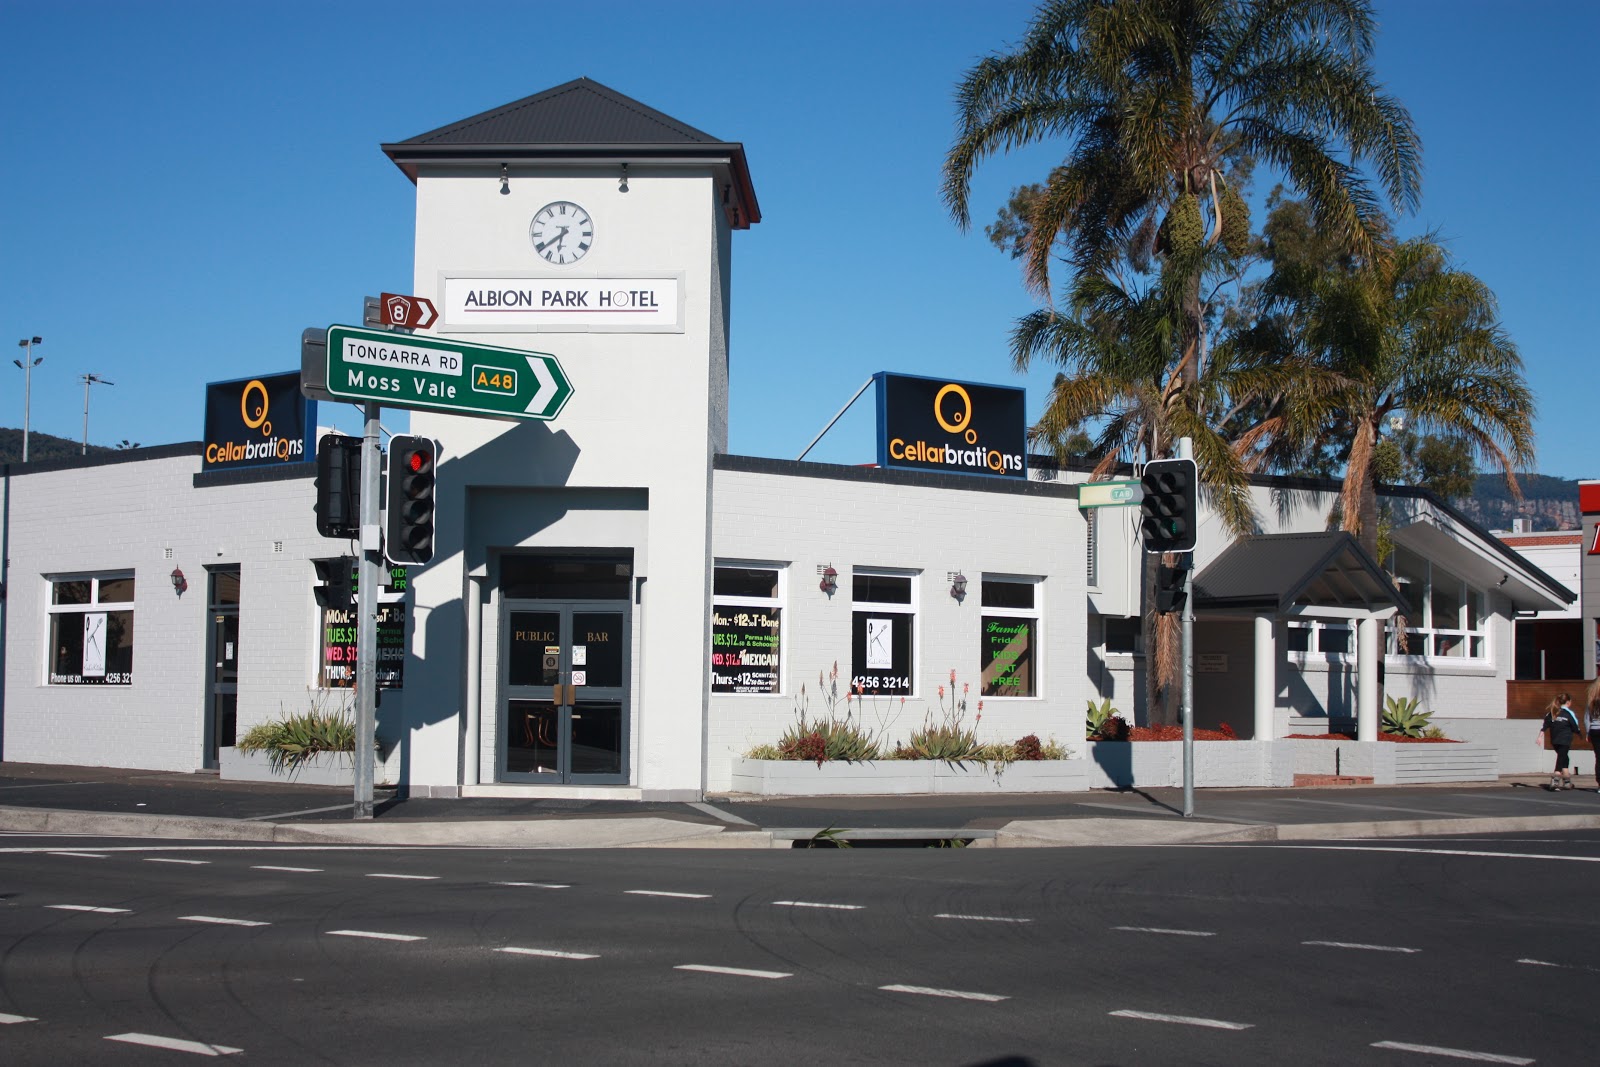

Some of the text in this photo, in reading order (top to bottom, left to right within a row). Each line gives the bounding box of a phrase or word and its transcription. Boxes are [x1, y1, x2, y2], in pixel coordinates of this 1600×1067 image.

[464, 290, 659, 307] ALBION PARK HOTEL
[393, 305, 404, 321] 8
[347, 343, 459, 370] TONGARRA RD
[348, 368, 457, 399] Moss Vale
[476, 371, 513, 390] A48
[205, 436, 304, 464] Cellarbrations
[889, 438, 1023, 474] Cellarbrations
[1114, 490, 1130, 498] TAB
[515, 630, 609, 642] PUBLIC BAR
[986, 621, 1029, 638] Family
[991, 636, 1023, 645] Friday
[741, 653, 779, 667] MEXICAN
[993, 650, 1019, 660] KIDS
[995, 664, 1017, 673] EAT
[50, 672, 67, 684] Phone
[67, 675, 75, 684] us
[105, 672, 121, 684] 4256
[851, 675, 909, 689] 4256 3214
[992, 676, 1020, 686] FREE
